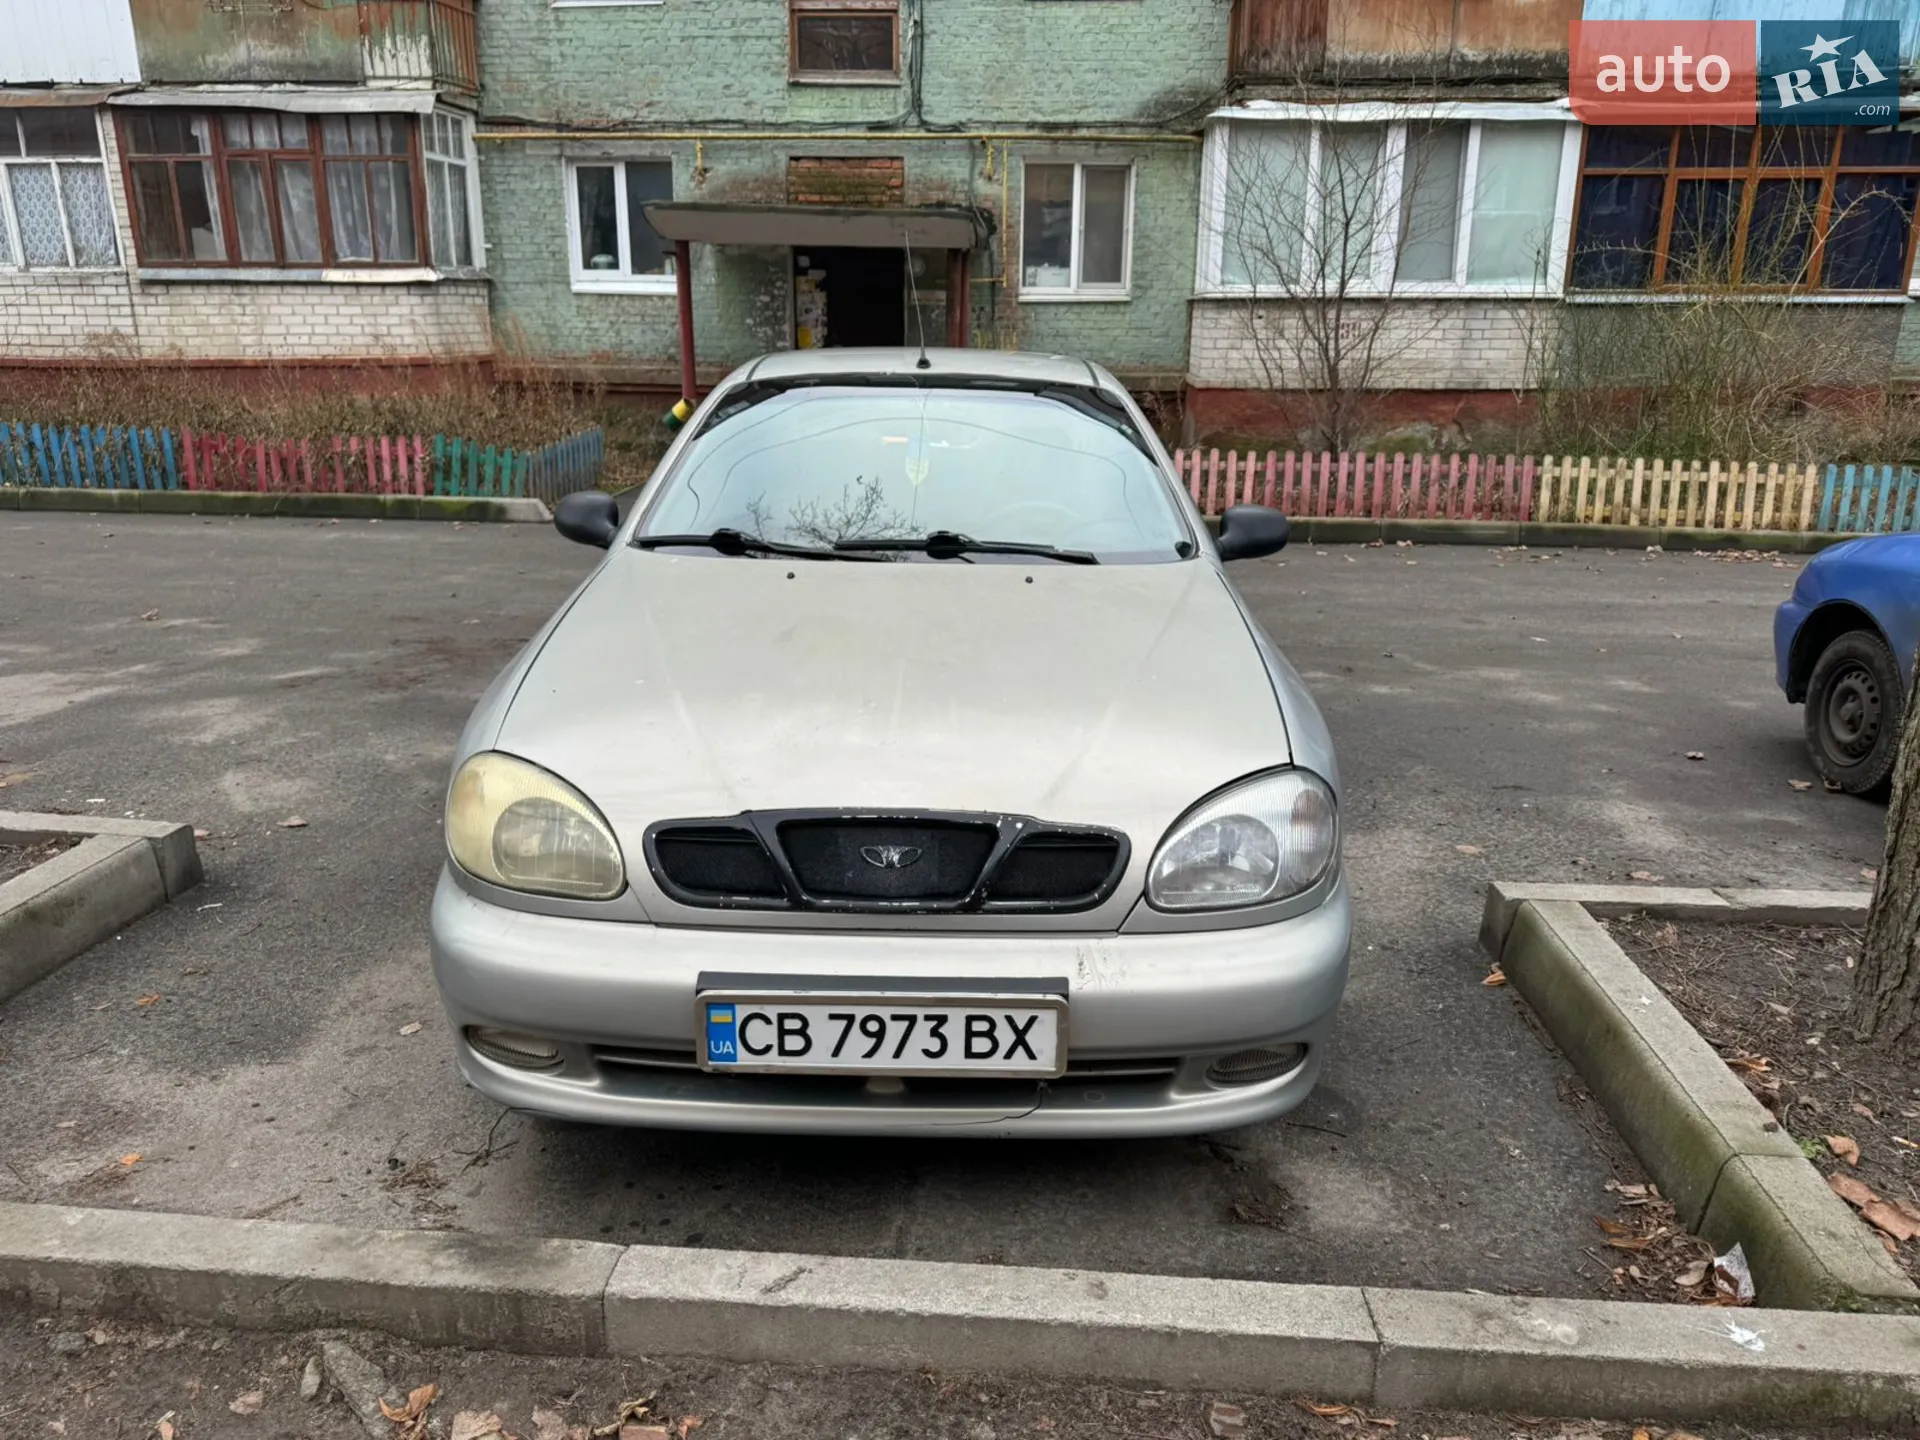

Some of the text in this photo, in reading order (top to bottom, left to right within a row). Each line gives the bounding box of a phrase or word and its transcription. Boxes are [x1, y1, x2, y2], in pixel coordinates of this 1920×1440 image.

[710, 1040, 734, 1055] UA
[738, 1012, 1039, 1060] CB 7973 BX
